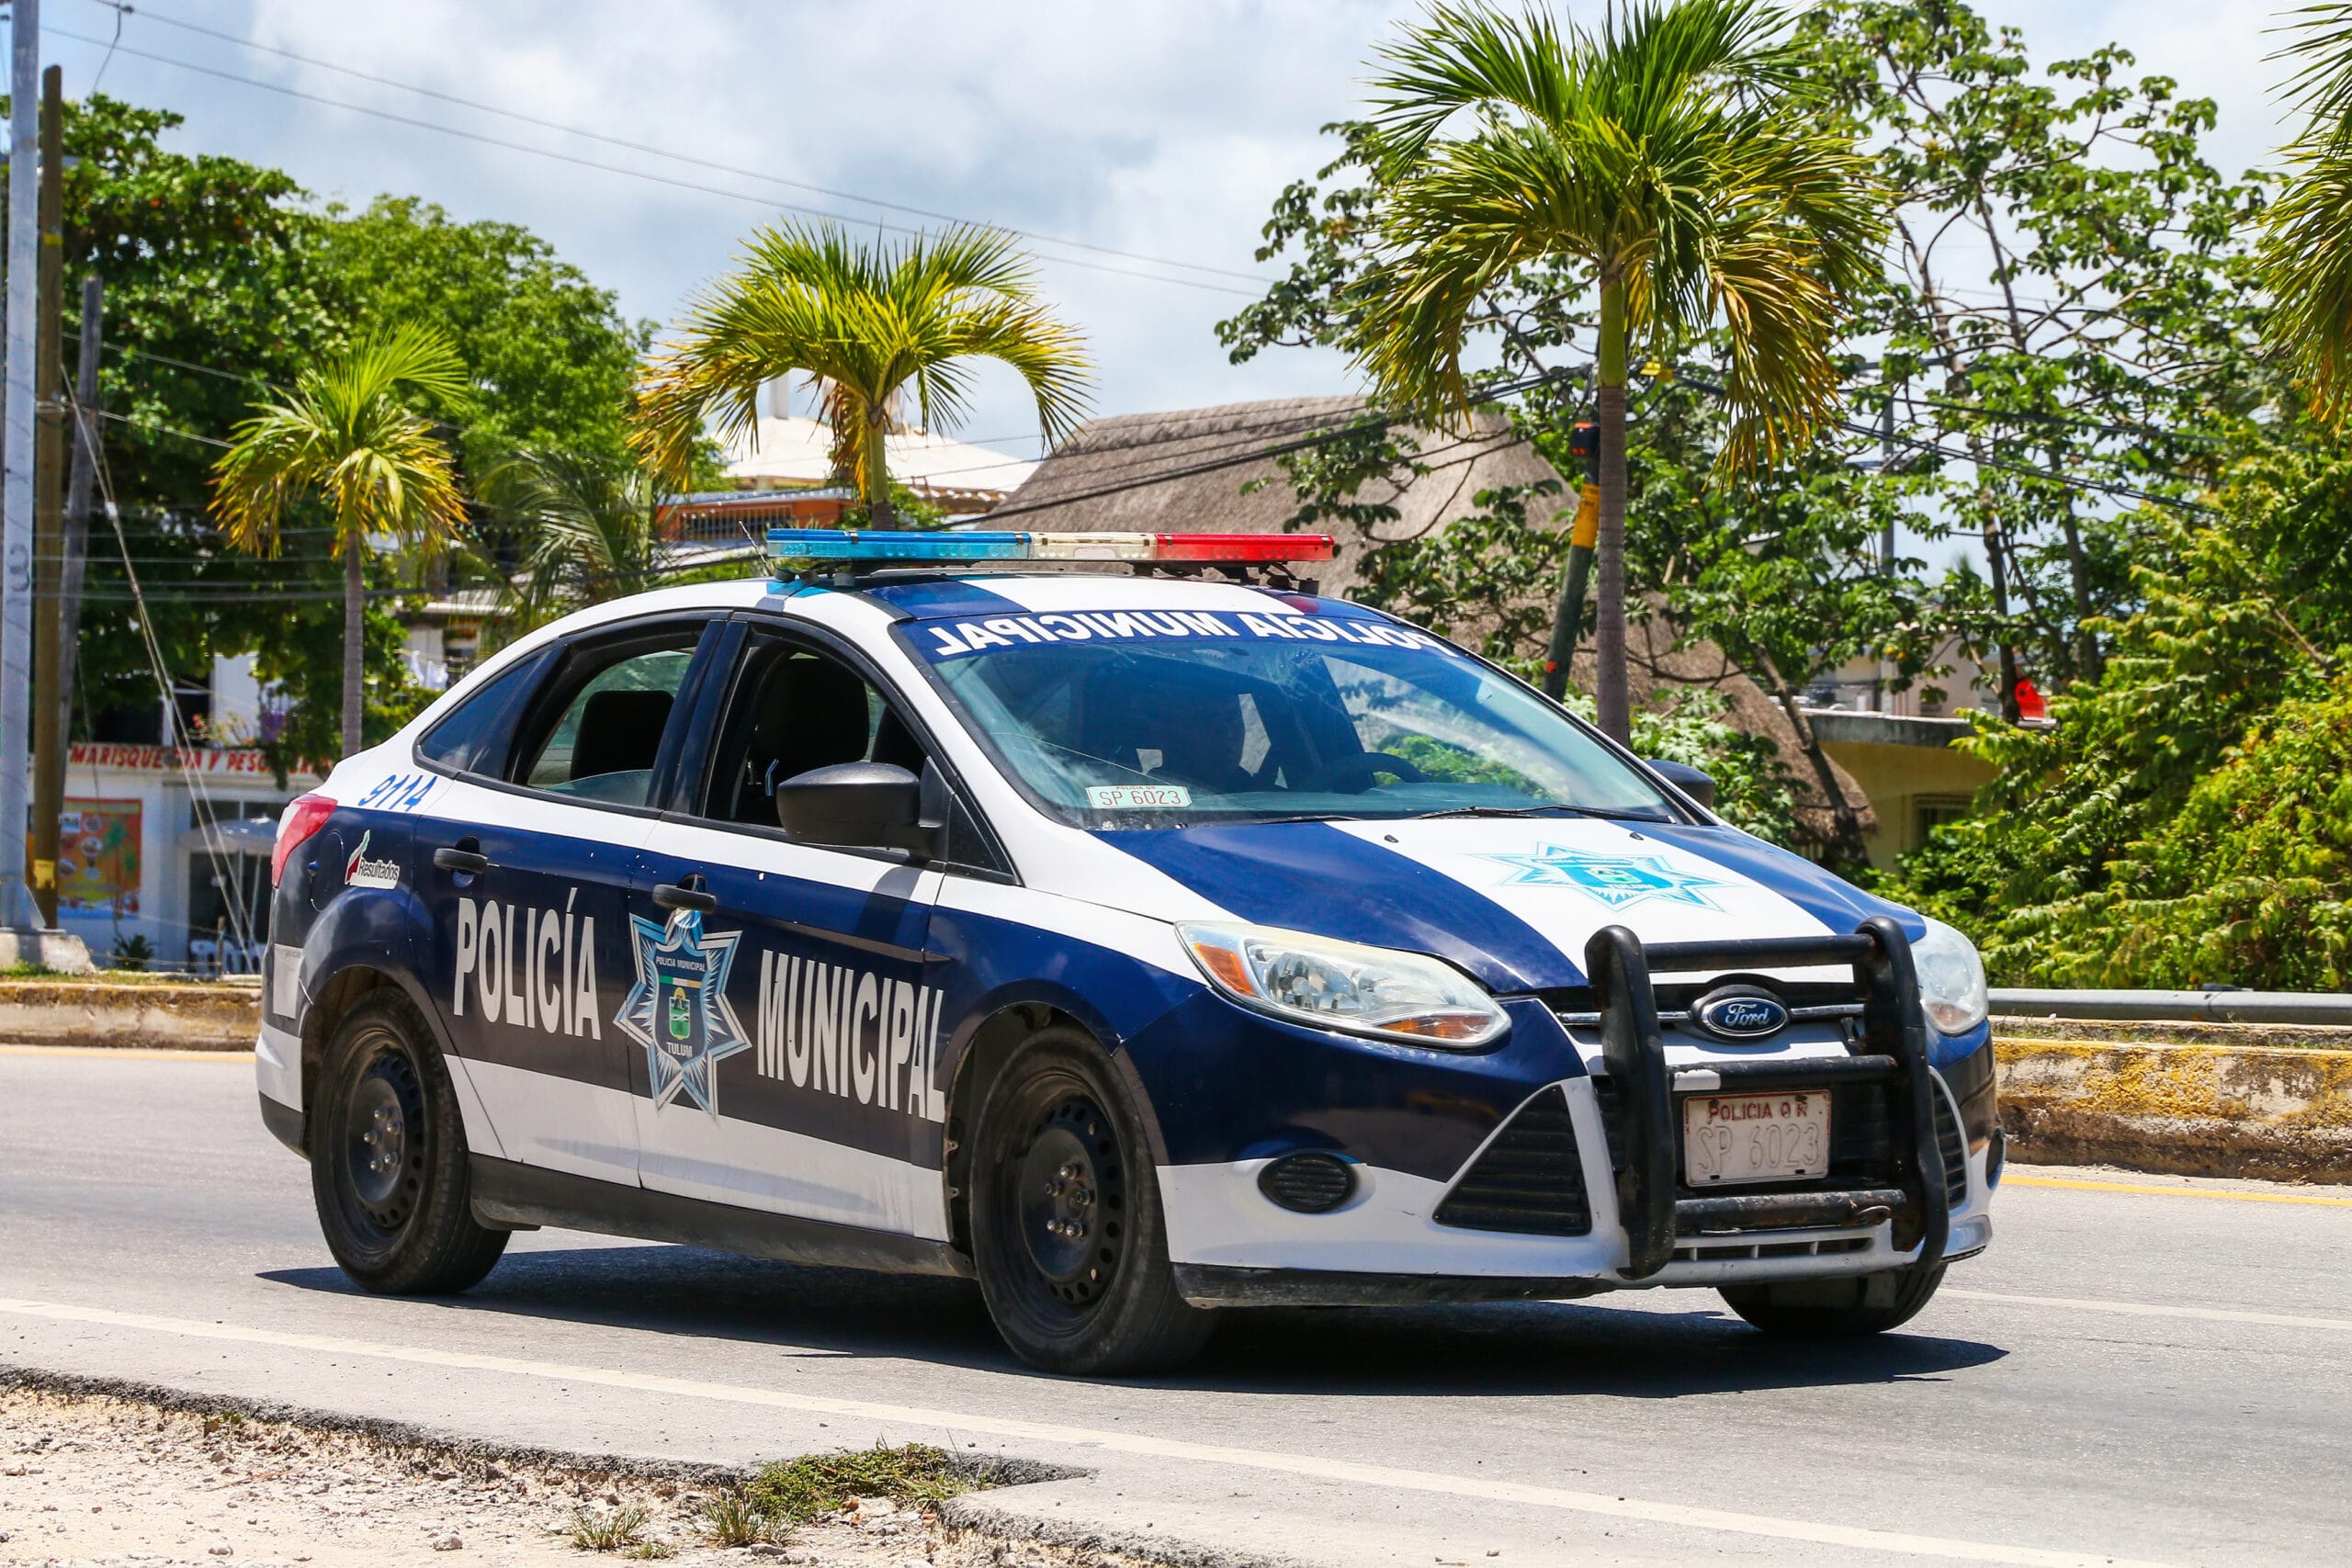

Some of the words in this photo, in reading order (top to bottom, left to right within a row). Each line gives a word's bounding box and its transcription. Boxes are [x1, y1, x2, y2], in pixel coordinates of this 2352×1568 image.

[357, 774, 438, 812] 9114
[1099, 791, 1123, 806] SP
[1130, 790, 1182, 805] 6023
[357, 859, 399, 881] Resultados
[655, 956, 676, 967] POLICIA
[677, 959, 706, 972] MUNICIPAL
[454, 887, 601, 1040] POLICÍA
[756, 949, 944, 1122] MUNICIPAL
[1725, 1003, 1770, 1026] Ford
[666, 1042, 693, 1057] TULUM
[1707, 1102, 1773, 1122] POLICIA
[1699, 1125, 1733, 1173] SP
[1749, 1122, 1820, 1168] 6023
